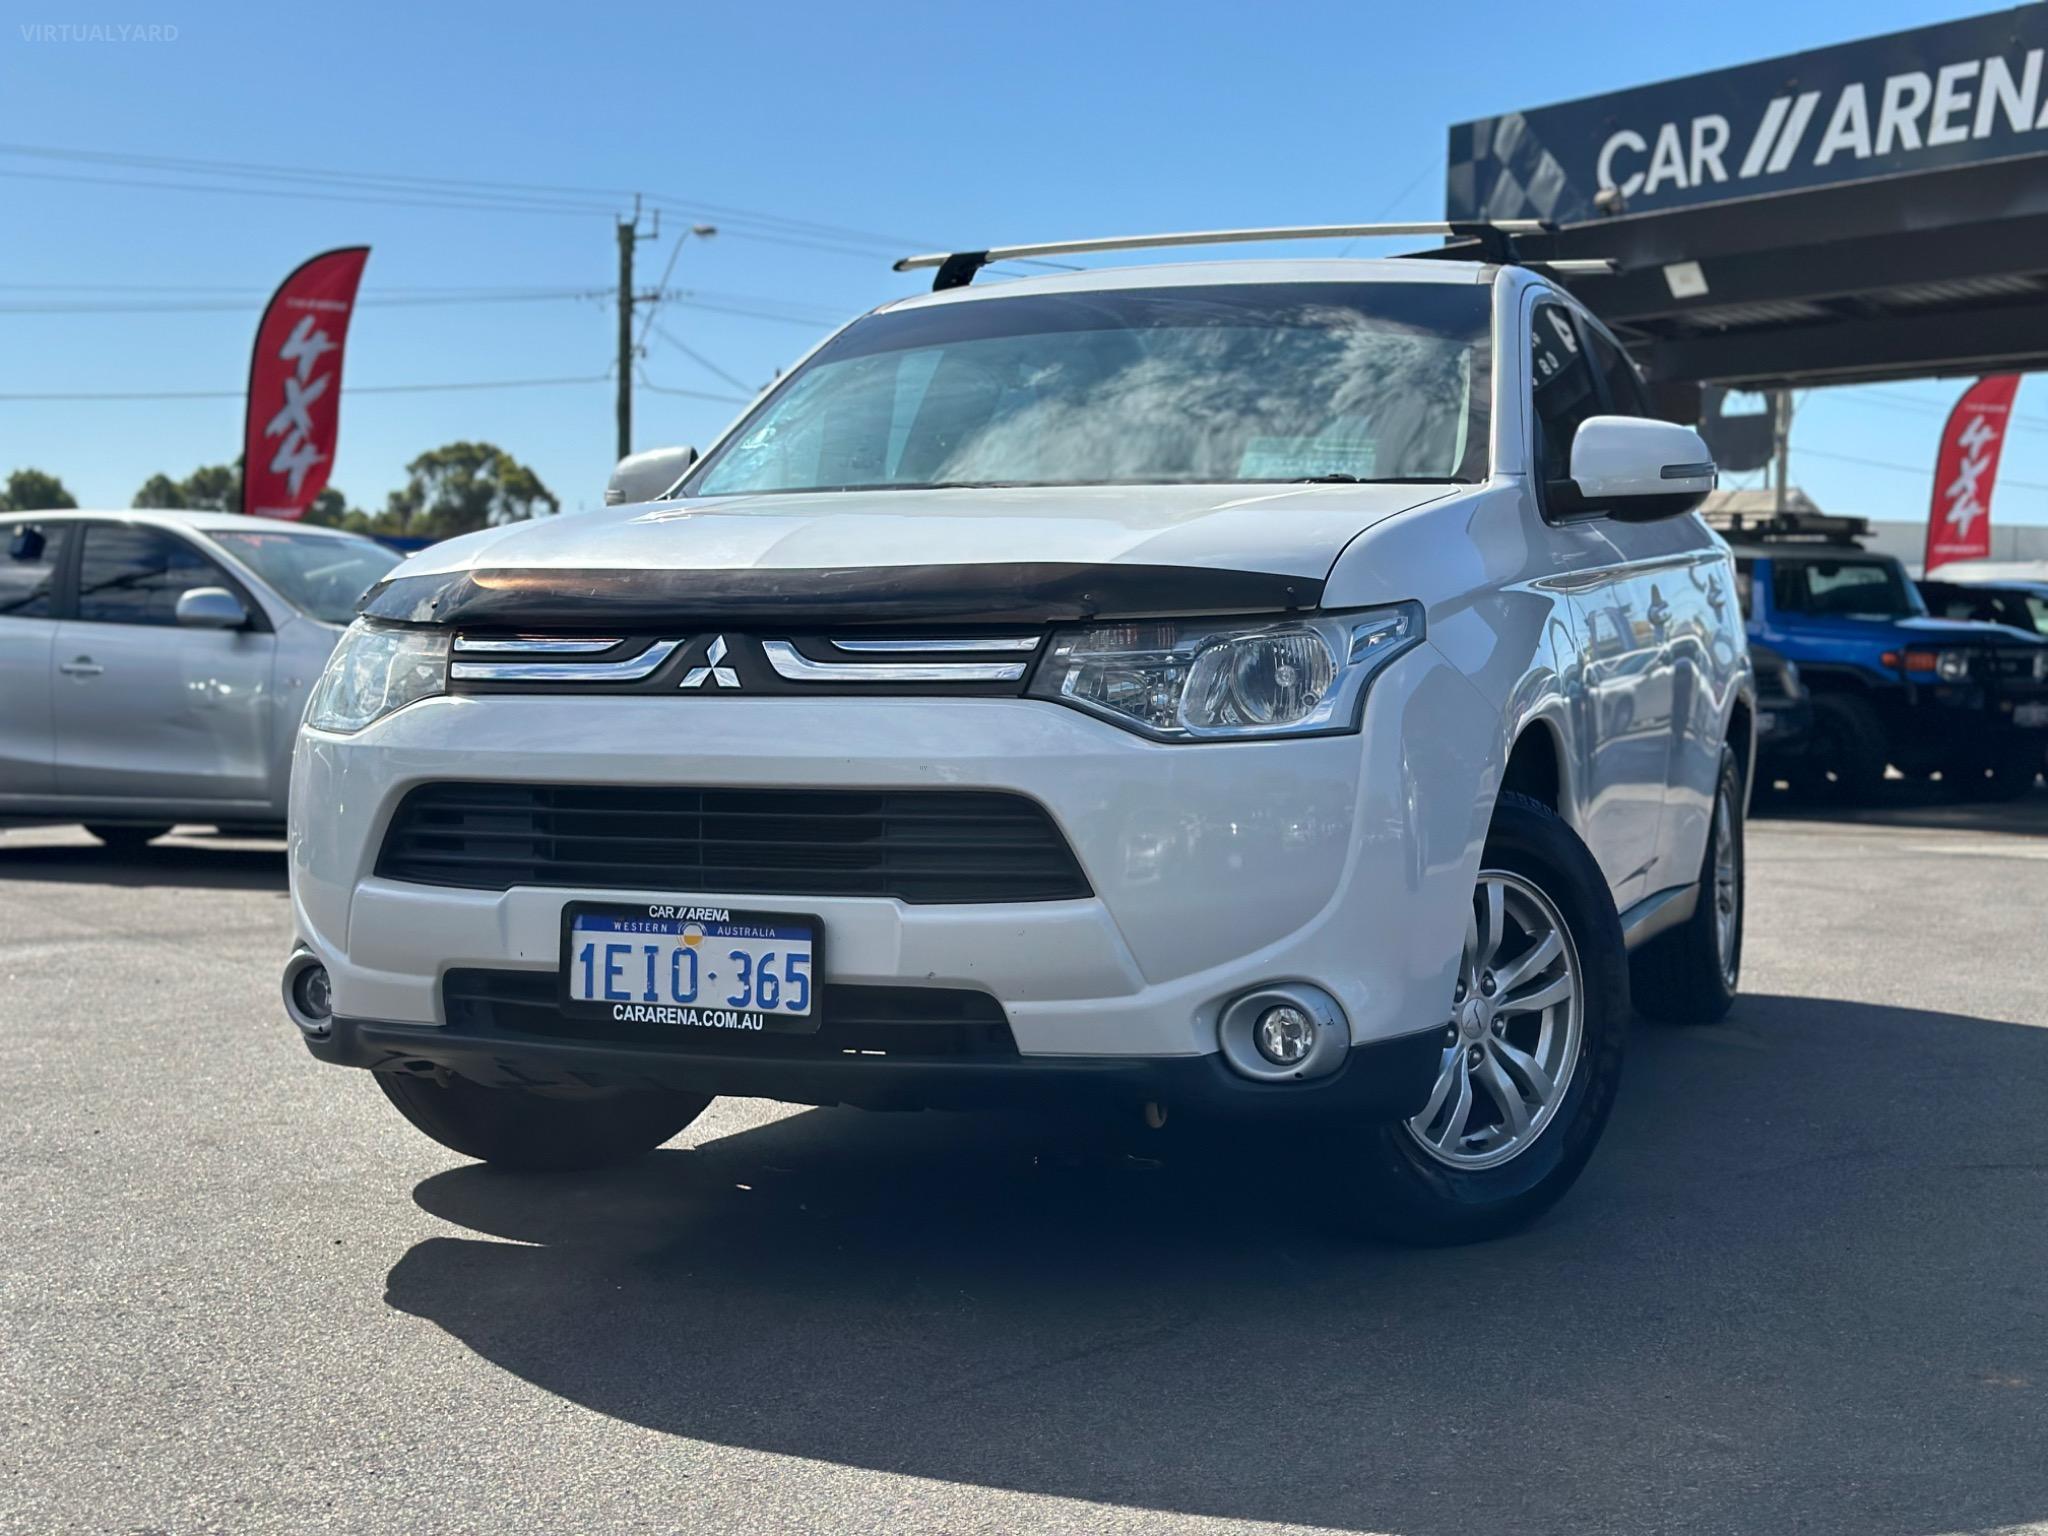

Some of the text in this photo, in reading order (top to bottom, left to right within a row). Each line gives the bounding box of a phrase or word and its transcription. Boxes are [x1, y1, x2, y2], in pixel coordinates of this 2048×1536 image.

[1598, 48, 2048, 199] CAR AREN
[648, 905, 675, 919] CAR
[613, 921, 776, 938] WESTERN AUSTRALIA
[612, 1004, 764, 1031] CARARENA.COM.AU
